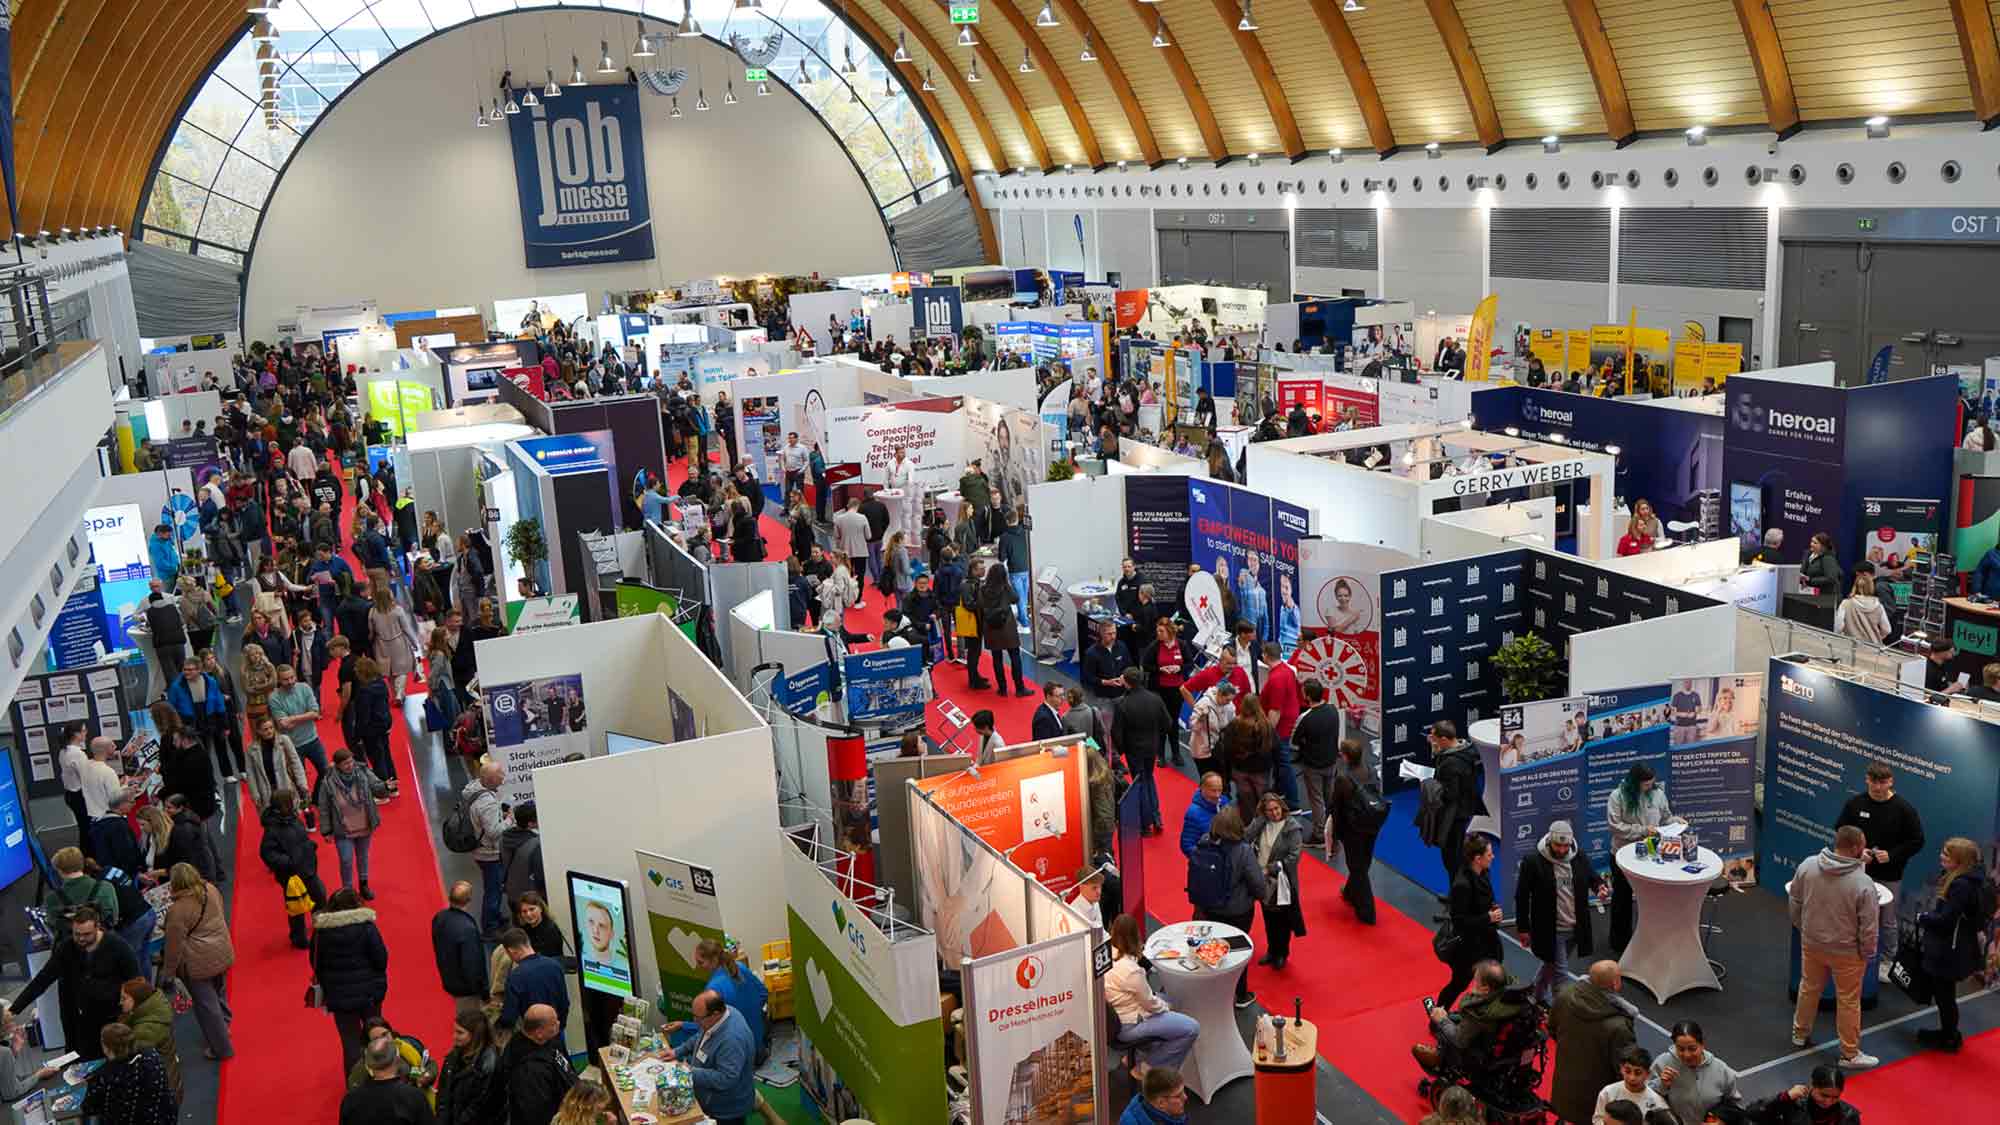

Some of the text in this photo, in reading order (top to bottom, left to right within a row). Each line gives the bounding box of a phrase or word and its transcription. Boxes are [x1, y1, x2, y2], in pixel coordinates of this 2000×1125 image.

[531, 101, 625, 226] job
[560, 183, 628, 211] messe
[1952, 215, 1987, 233] OST
[924, 296, 952, 336] job
[1540, 406, 1573, 422] heroal
[1768, 409, 1836, 435] heroal
[866, 424, 922, 438] Connecting
[882, 429, 936, 444] People and
[865, 451, 881, 464] for
[1454, 462, 1584, 496] GERRY WEBER
[1784, 489, 1812, 502] Erfahre
[1784, 501, 1823, 515] mehr über
[1865, 503, 1881, 514] 28
[1784, 511, 1807, 524] heroal
[1199, 518, 1277, 554] EMPOWERING
[1207, 537, 1214, 549] to
[1215, 539, 1230, 554] start
[1957, 625, 1991, 649] Hey!
[1791, 682, 1814, 699] CTO
[1599, 695, 1618, 705] CTO
[1503, 711, 1521, 726] 54
[509, 750, 535, 761] Stark
[694, 873, 713, 890] 82
[1095, 949, 1111, 971] 81
[988, 989, 1073, 1023] Dresselhaus
